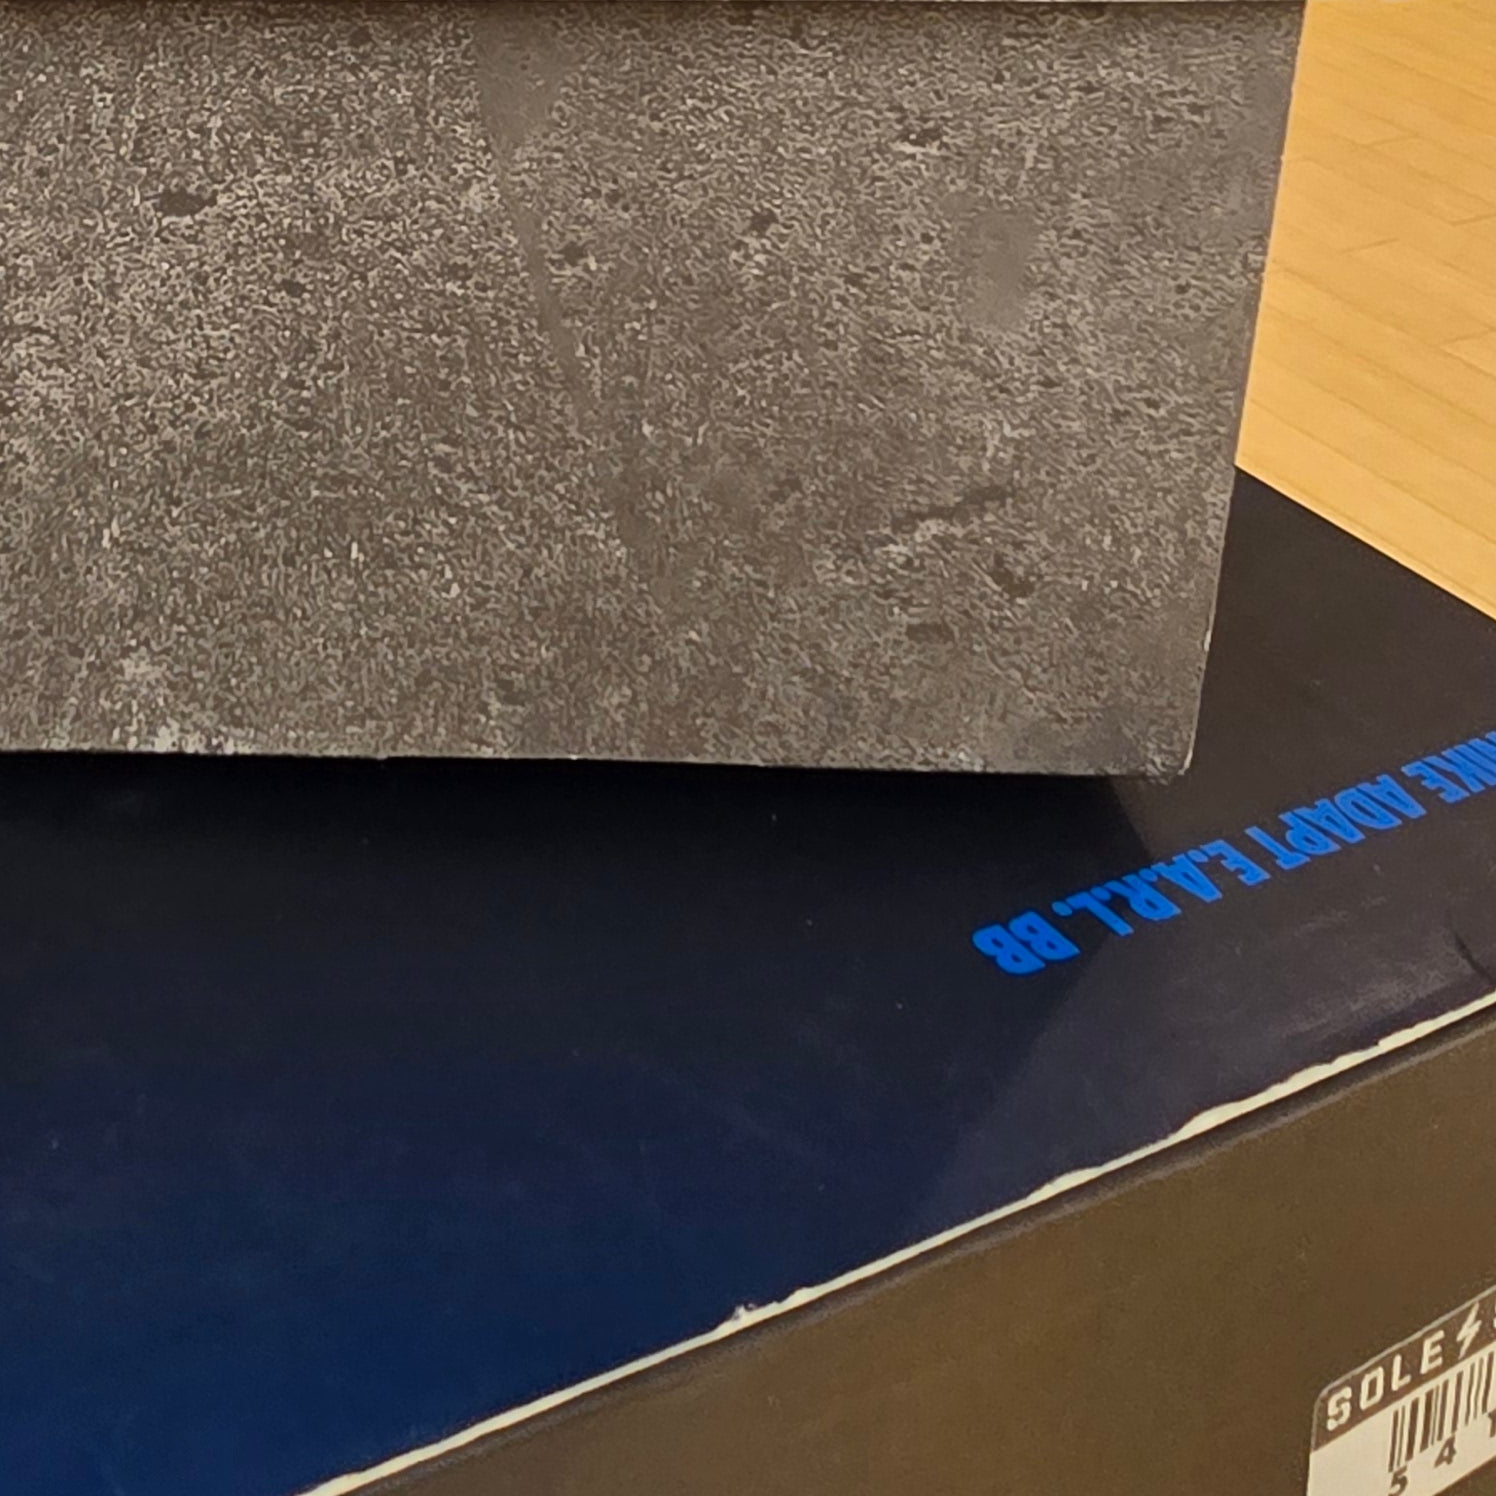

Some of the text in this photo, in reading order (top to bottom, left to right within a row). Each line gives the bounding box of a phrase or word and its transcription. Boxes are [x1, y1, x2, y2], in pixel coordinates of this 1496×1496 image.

[1244, 774, 1426, 870] ADAPT
[971, 910, 1081, 976] BB
[1326, 1329, 1445, 1431] SOLE
